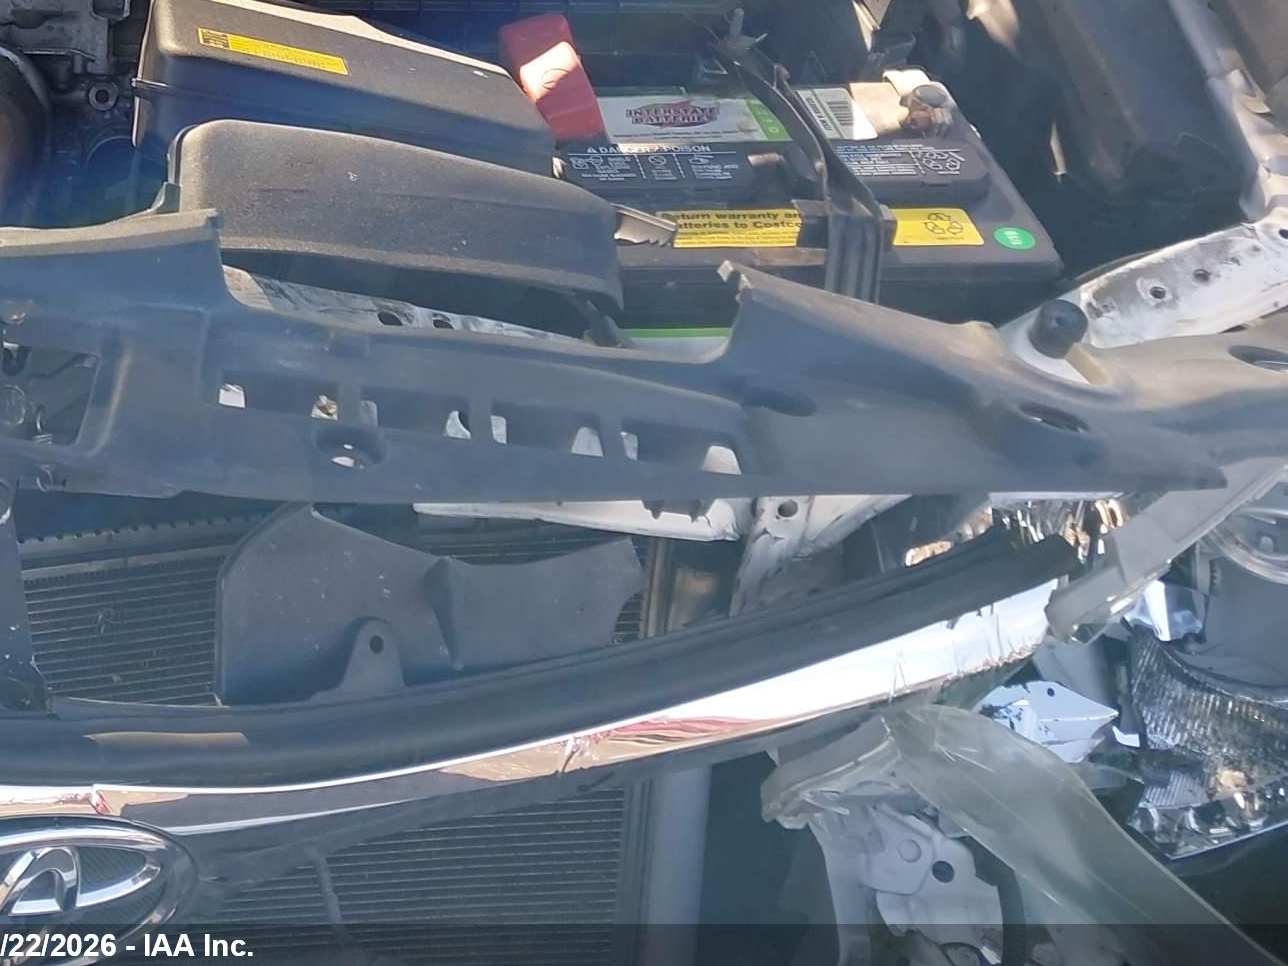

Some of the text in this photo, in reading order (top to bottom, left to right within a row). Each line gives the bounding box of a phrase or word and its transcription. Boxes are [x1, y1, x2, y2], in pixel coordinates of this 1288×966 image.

[626, 106, 721, 117] INTERSTATE
[631, 115, 719, 125] BATTERIES
[663, 145, 711, 153] POISON
[715, 212, 778, 221] warranty
[677, 220, 803, 229] atteries to Costco
